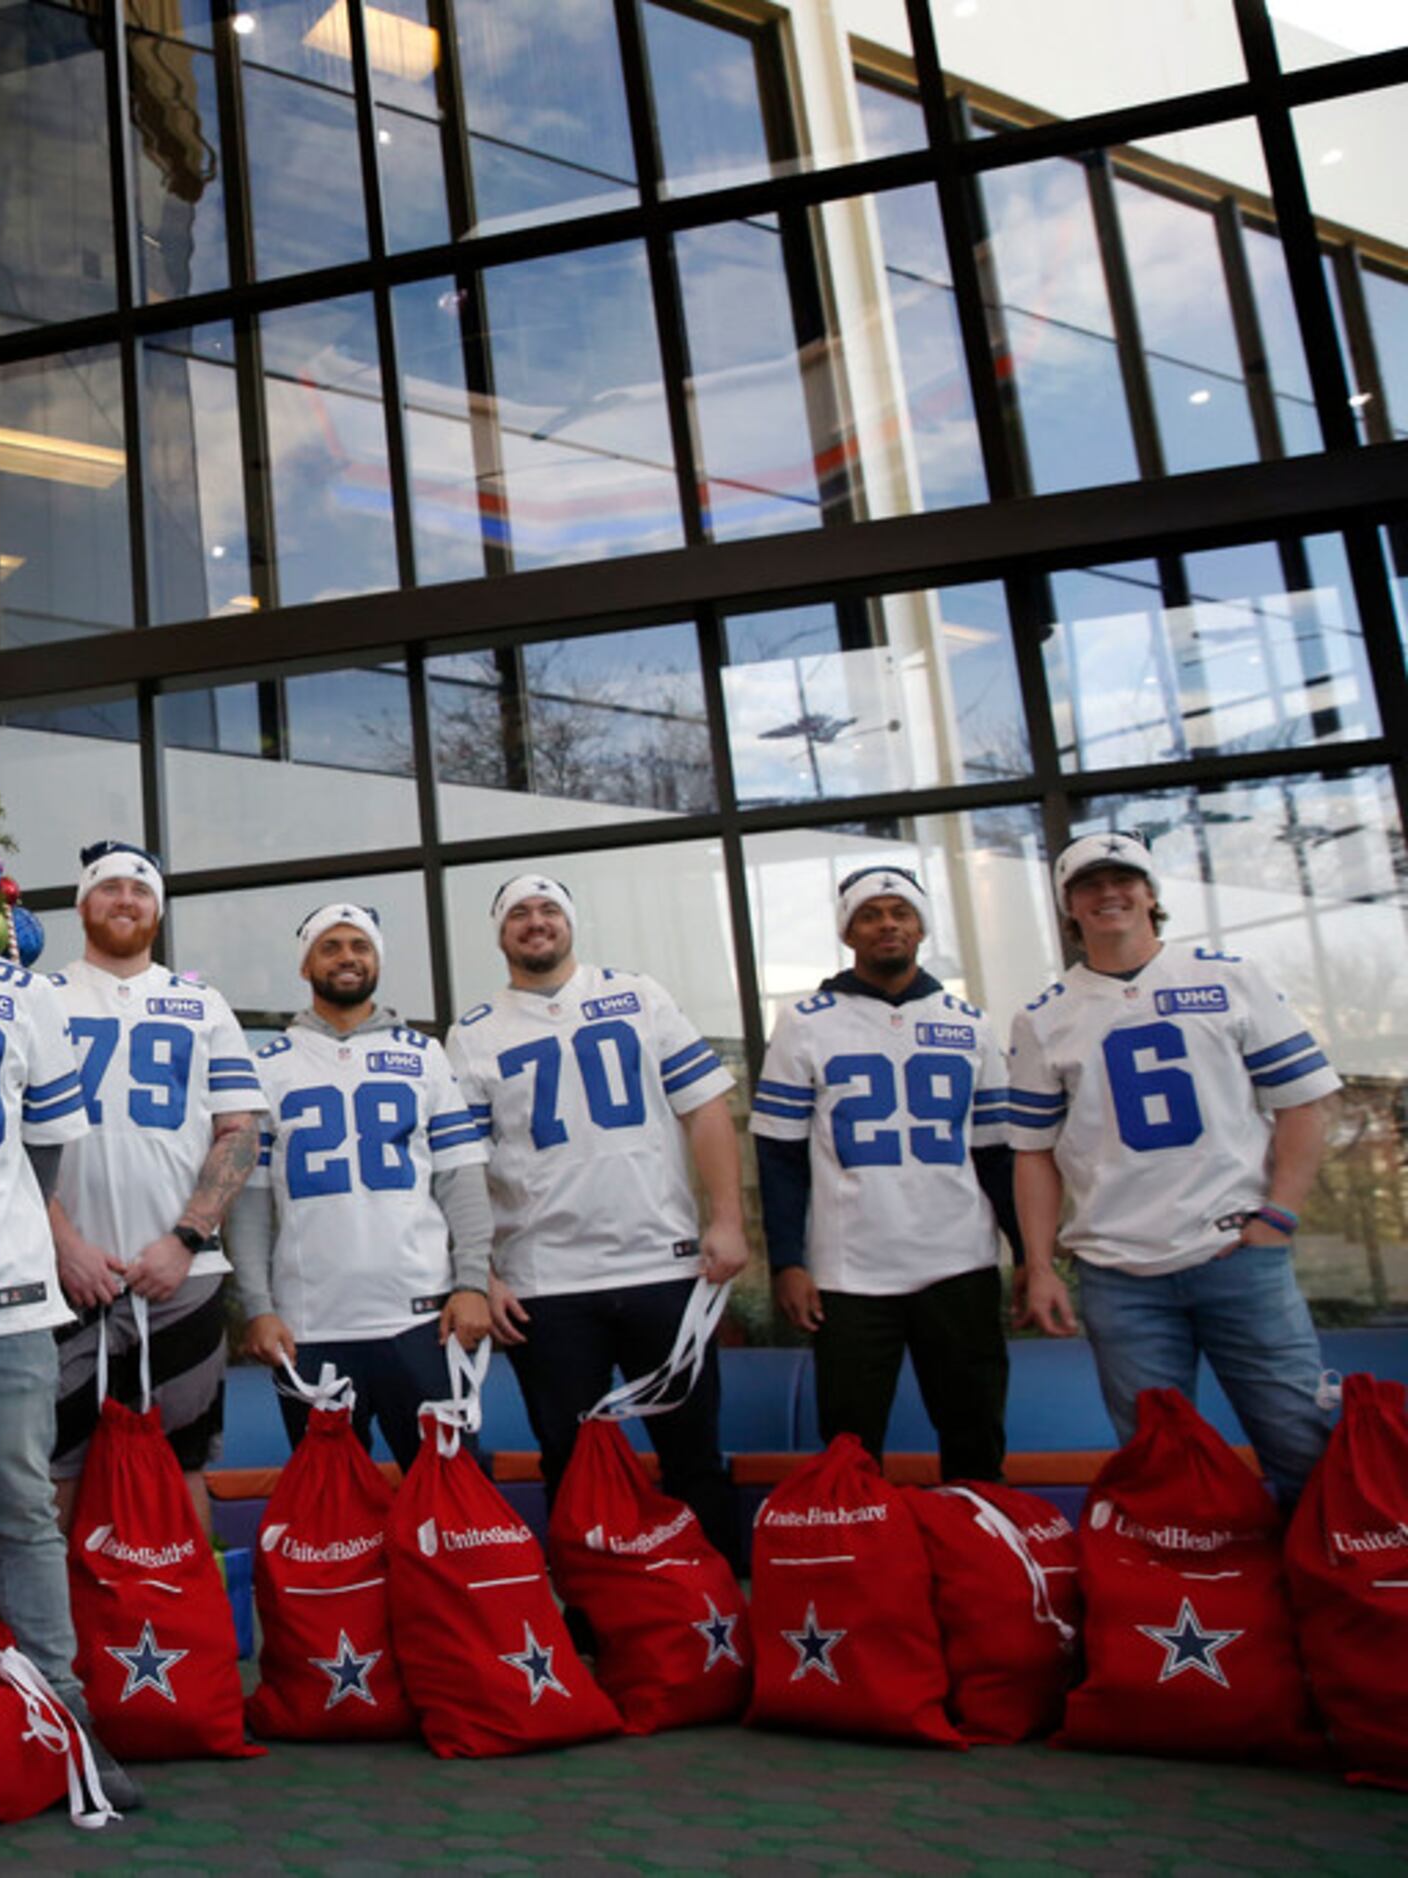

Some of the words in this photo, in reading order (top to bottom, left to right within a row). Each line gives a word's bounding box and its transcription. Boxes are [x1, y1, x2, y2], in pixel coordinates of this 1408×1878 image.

[935, 1026, 973, 1043] UHC
[1176, 988, 1224, 1009] UHC
[67, 1017, 194, 1131] 79
[497, 1020, 647, 1150] 70
[824, 1053, 974, 1169] 29
[1103, 1022, 1203, 1152] 6
[279, 1082, 418, 1200] 28
